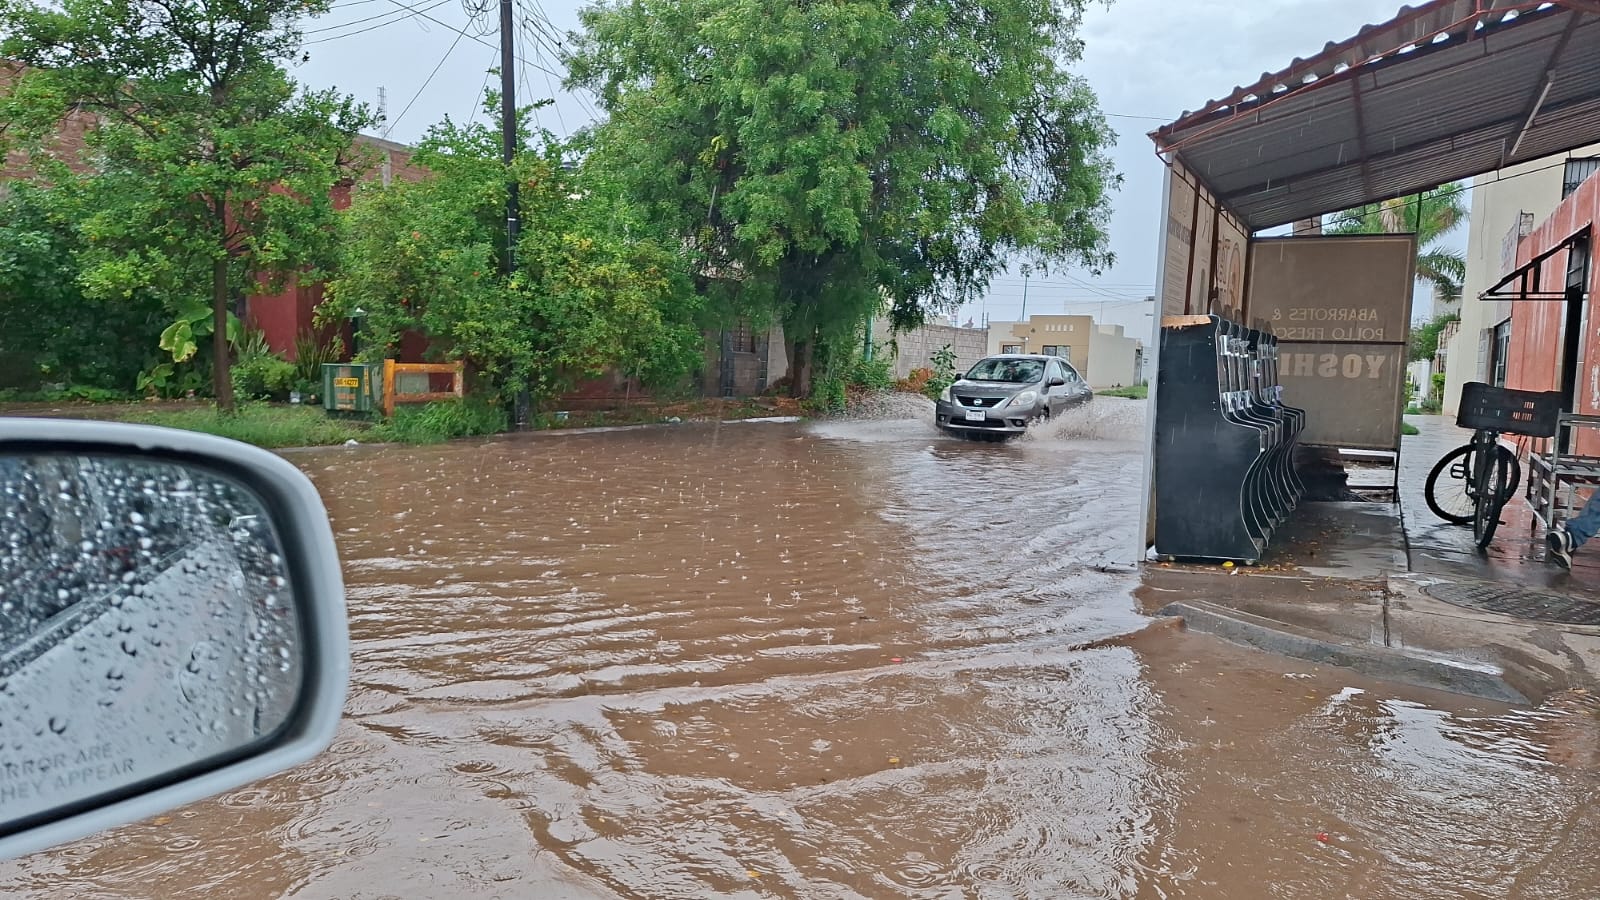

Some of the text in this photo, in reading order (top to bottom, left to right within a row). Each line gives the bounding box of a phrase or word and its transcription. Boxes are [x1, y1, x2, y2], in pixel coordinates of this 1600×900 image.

[0, 742, 112, 780] IRROR ARE
[0, 758, 135, 802] HEY APPEAR
